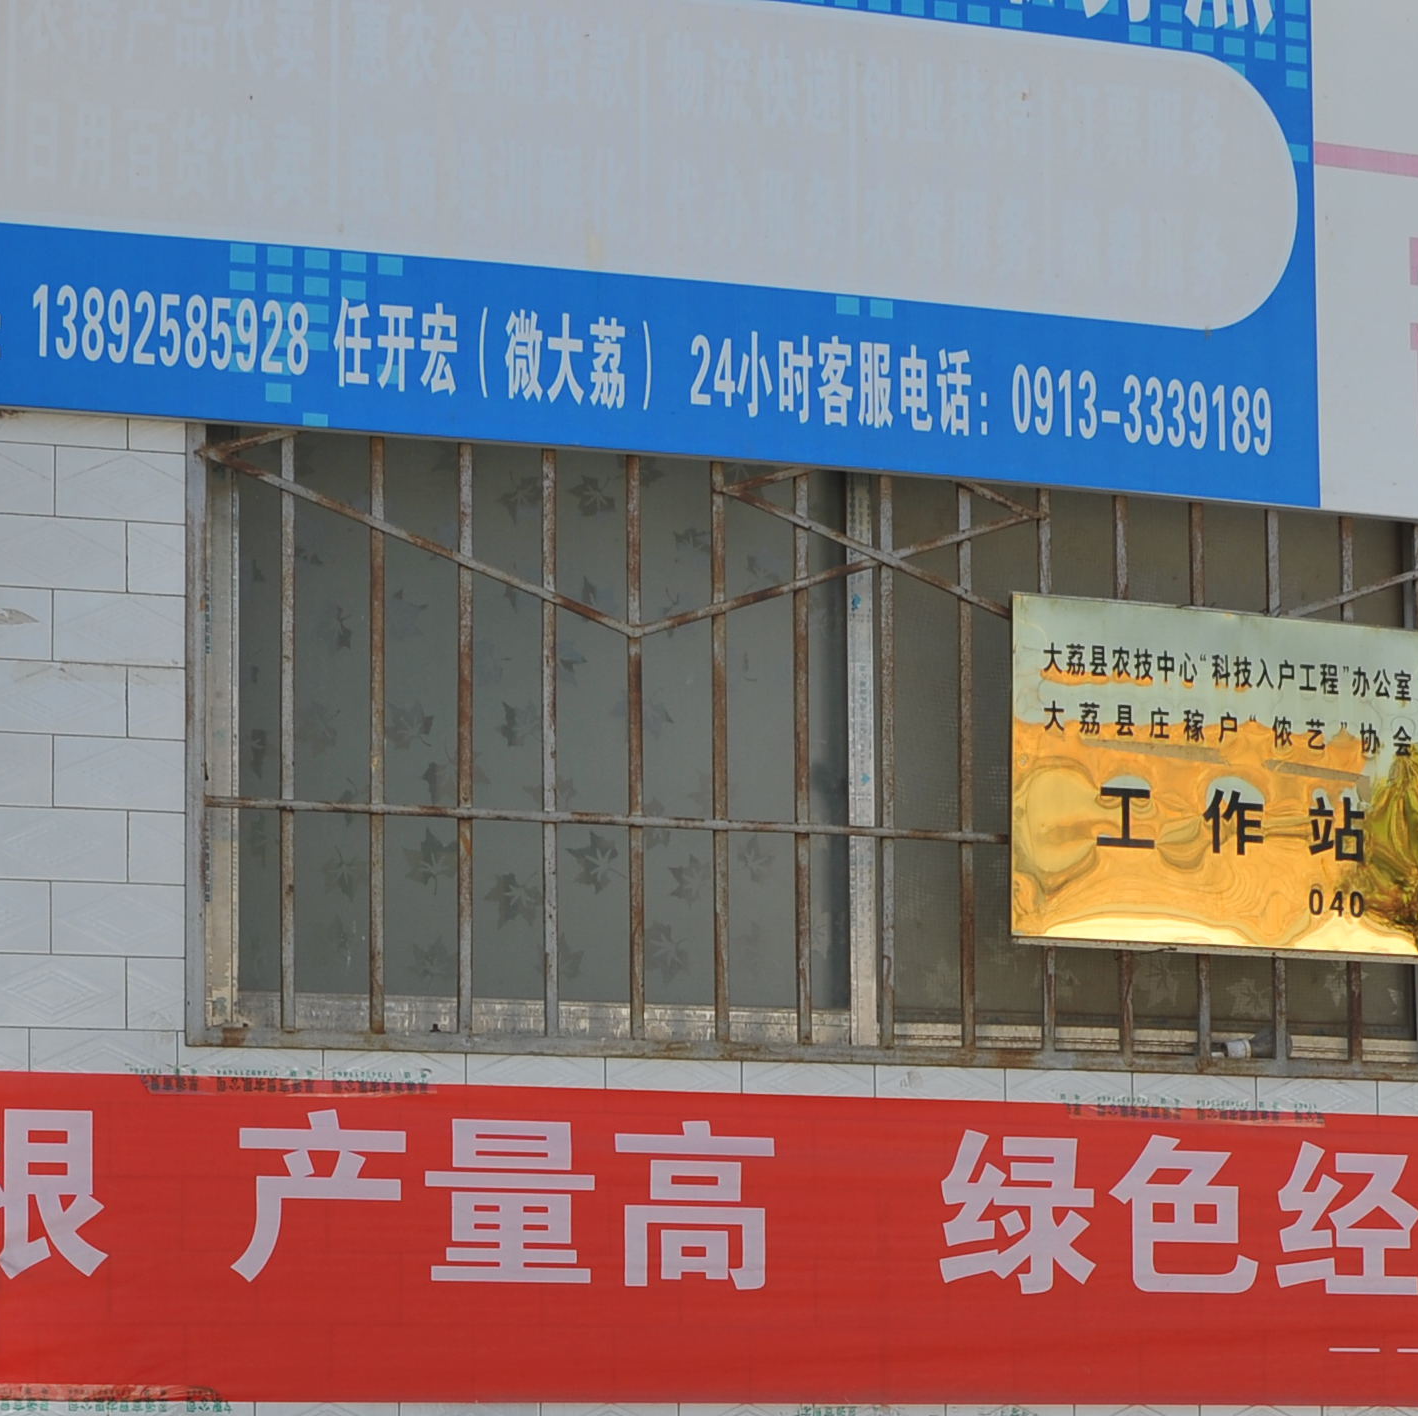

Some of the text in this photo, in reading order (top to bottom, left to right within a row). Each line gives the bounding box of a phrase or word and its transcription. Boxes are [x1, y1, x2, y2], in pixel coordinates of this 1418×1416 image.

[1095, 785, 1367, 863] 工作站
[1307, 888, 1366, 919] 040
[230, 1108, 775, 1291] 产量高
